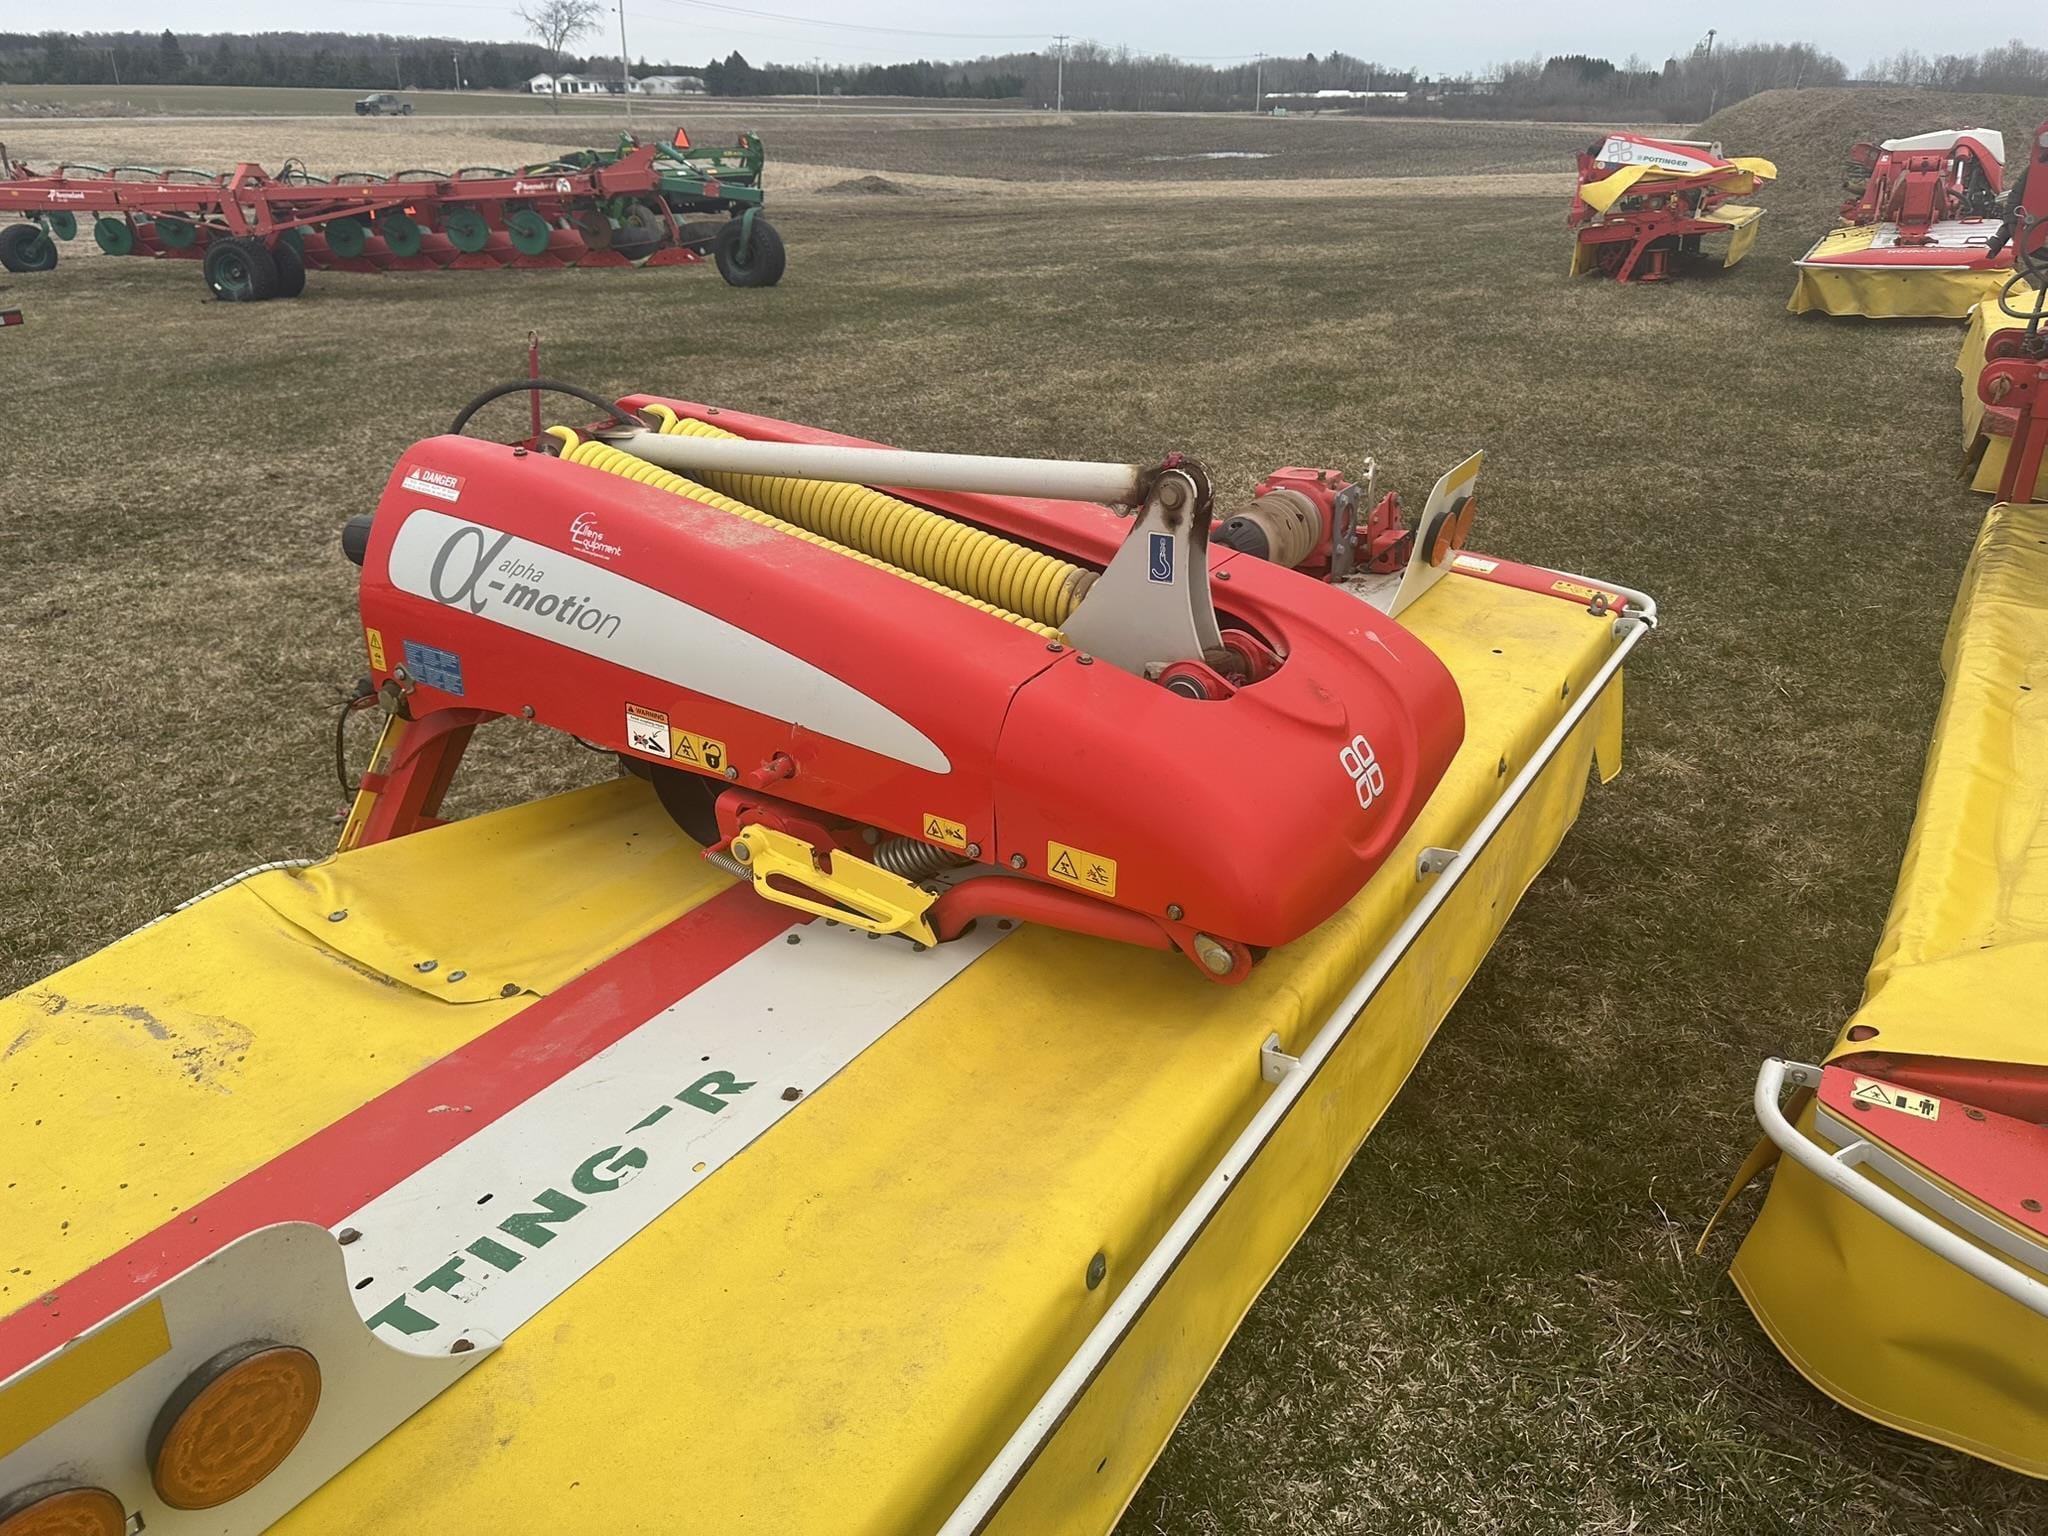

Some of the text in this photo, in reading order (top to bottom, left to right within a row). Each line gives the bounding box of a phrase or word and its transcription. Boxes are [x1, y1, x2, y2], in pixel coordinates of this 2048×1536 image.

[422, 470, 458, 489] DANGER
[498, 558, 545, 583] alpha
[635, 706, 665, 721] WARNING
